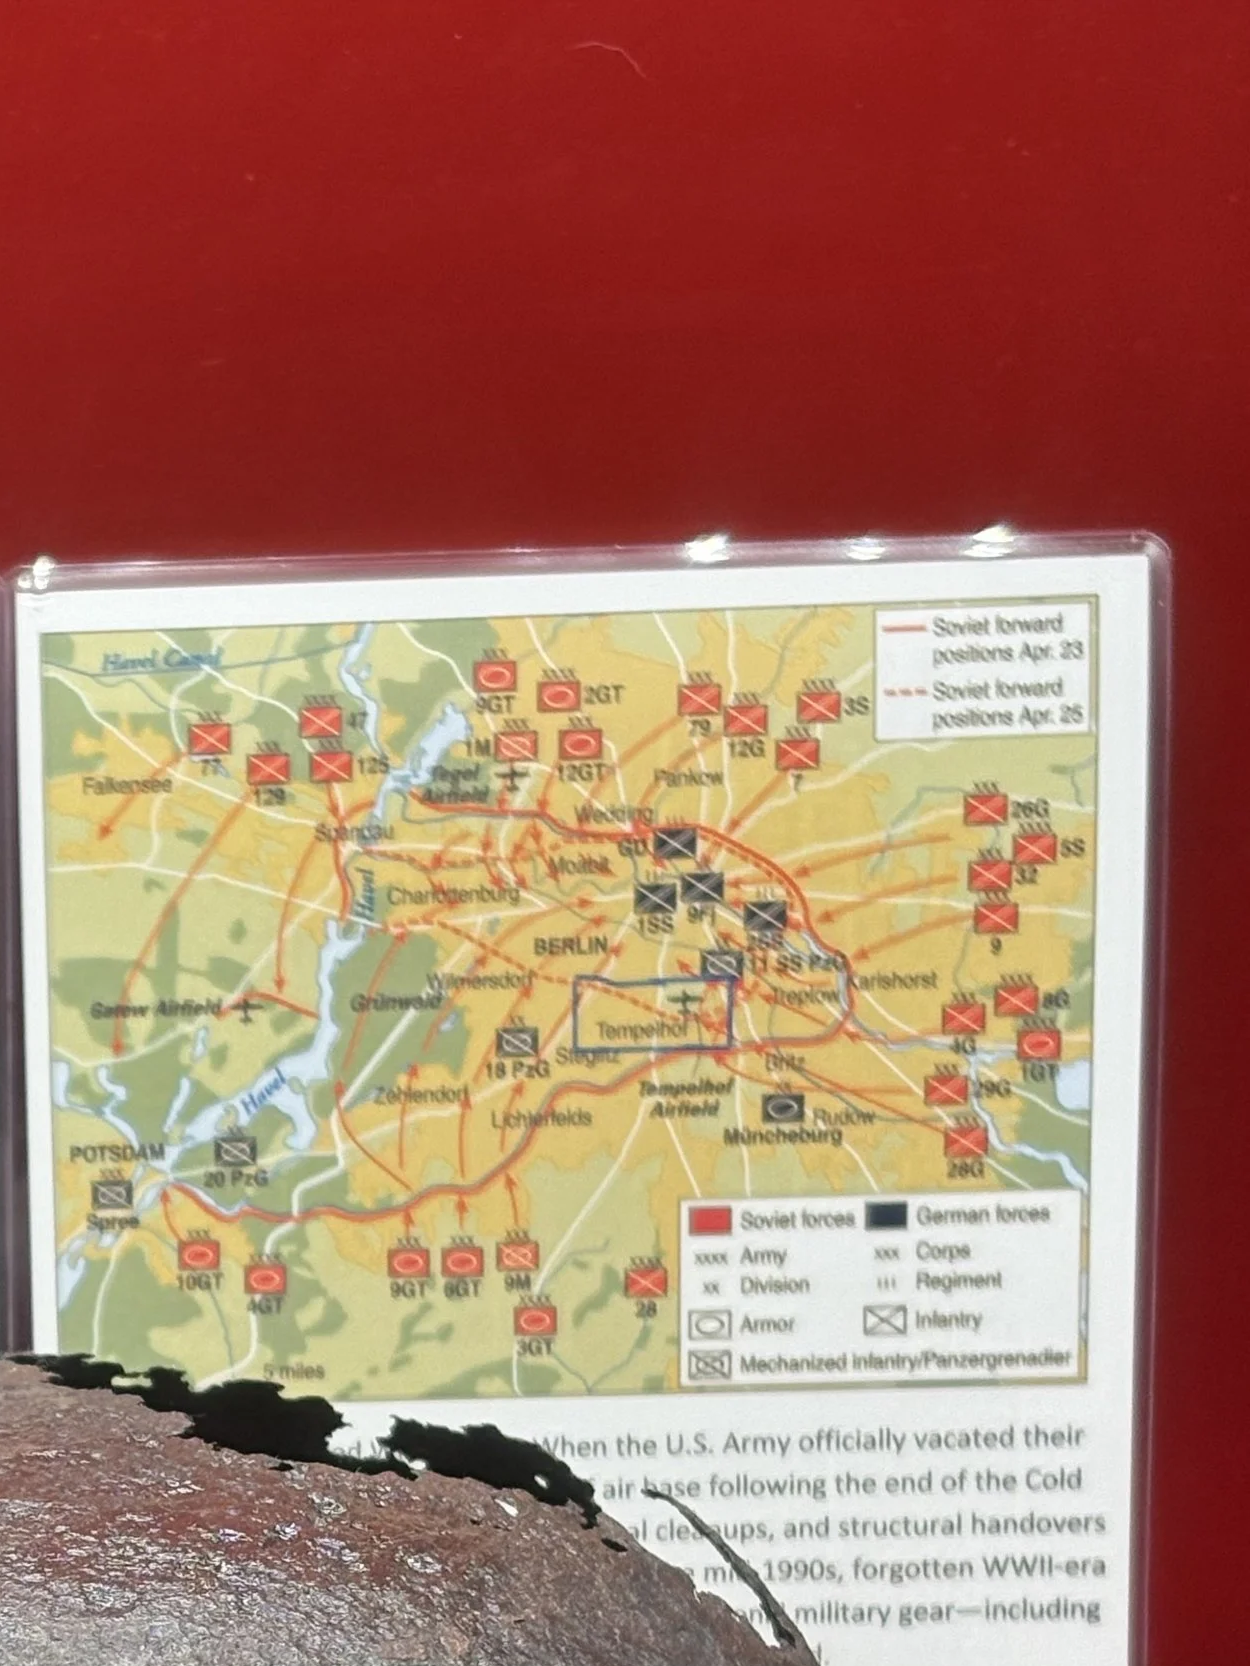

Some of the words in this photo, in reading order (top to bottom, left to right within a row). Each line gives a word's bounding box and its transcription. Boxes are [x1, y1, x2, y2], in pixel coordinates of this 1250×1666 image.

[932, 616, 991, 638] Soviet
[995, 612, 1064, 636] forward
[932, 643, 1014, 669] positions
[1018, 641, 1055, 665] Apr.
[1059, 639, 1085, 658] 23
[932, 679, 991, 701] Soviet
[995, 676, 1064, 699] forward
[932, 706, 1014, 732] positions
[1018, 705, 1055, 729] Apr.
[84, 776, 173, 796] Falkensee
[533, 936, 608, 956] BERLIN
[597, 1020, 688, 1041] Tempelhof
[70, 1143, 166, 1164] POTSDAM
[86, 1213, 141, 1232] Spree
[740, 1211, 797, 1232] Soviet
[801, 1209, 856, 1229] forces
[916, 1206, 990, 1226] German
[996, 1203, 1050, 1223] forces
[740, 1247, 788, 1270] Army
[916, 1242, 971, 1264] Corps
[390, 1280, 428, 1298] 9GT
[740, 1273, 810, 1295] Division
[916, 1270, 1002, 1292] Regiment
[739, 1315, 795, 1334] Armor
[915, 1310, 983, 1332] Infantry
[279, 1361, 326, 1380] miles
[740, 1352, 848, 1375] Mechanized
[617, 1433, 656, 1458] the
[667, 1433, 713, 1455] U.S.
[723, 1432, 790, 1458] Army
[799, 1427, 905, 1456] officially
[913, 1426, 1014, 1450] vacated
[1024, 1425, 1085, 1449] their
[604, 1478, 635, 1498] air
[710, 1472, 825, 1501] following
[835, 1472, 876, 1495] the
[886, 1469, 932, 1495] end
[942, 1468, 967, 1493] of
[976, 1467, 1017, 1492] the
[1026, 1466, 1082, 1490] Cold
[786, 1516, 829, 1539] and
[839, 1513, 961, 1538] structural
[972, 1510, 1105, 1535] handovers
[852, 1555, 974, 1586] forgotten
[983, 1554, 1105, 1578] WWII-era
[796, 1600, 891, 1630] military
